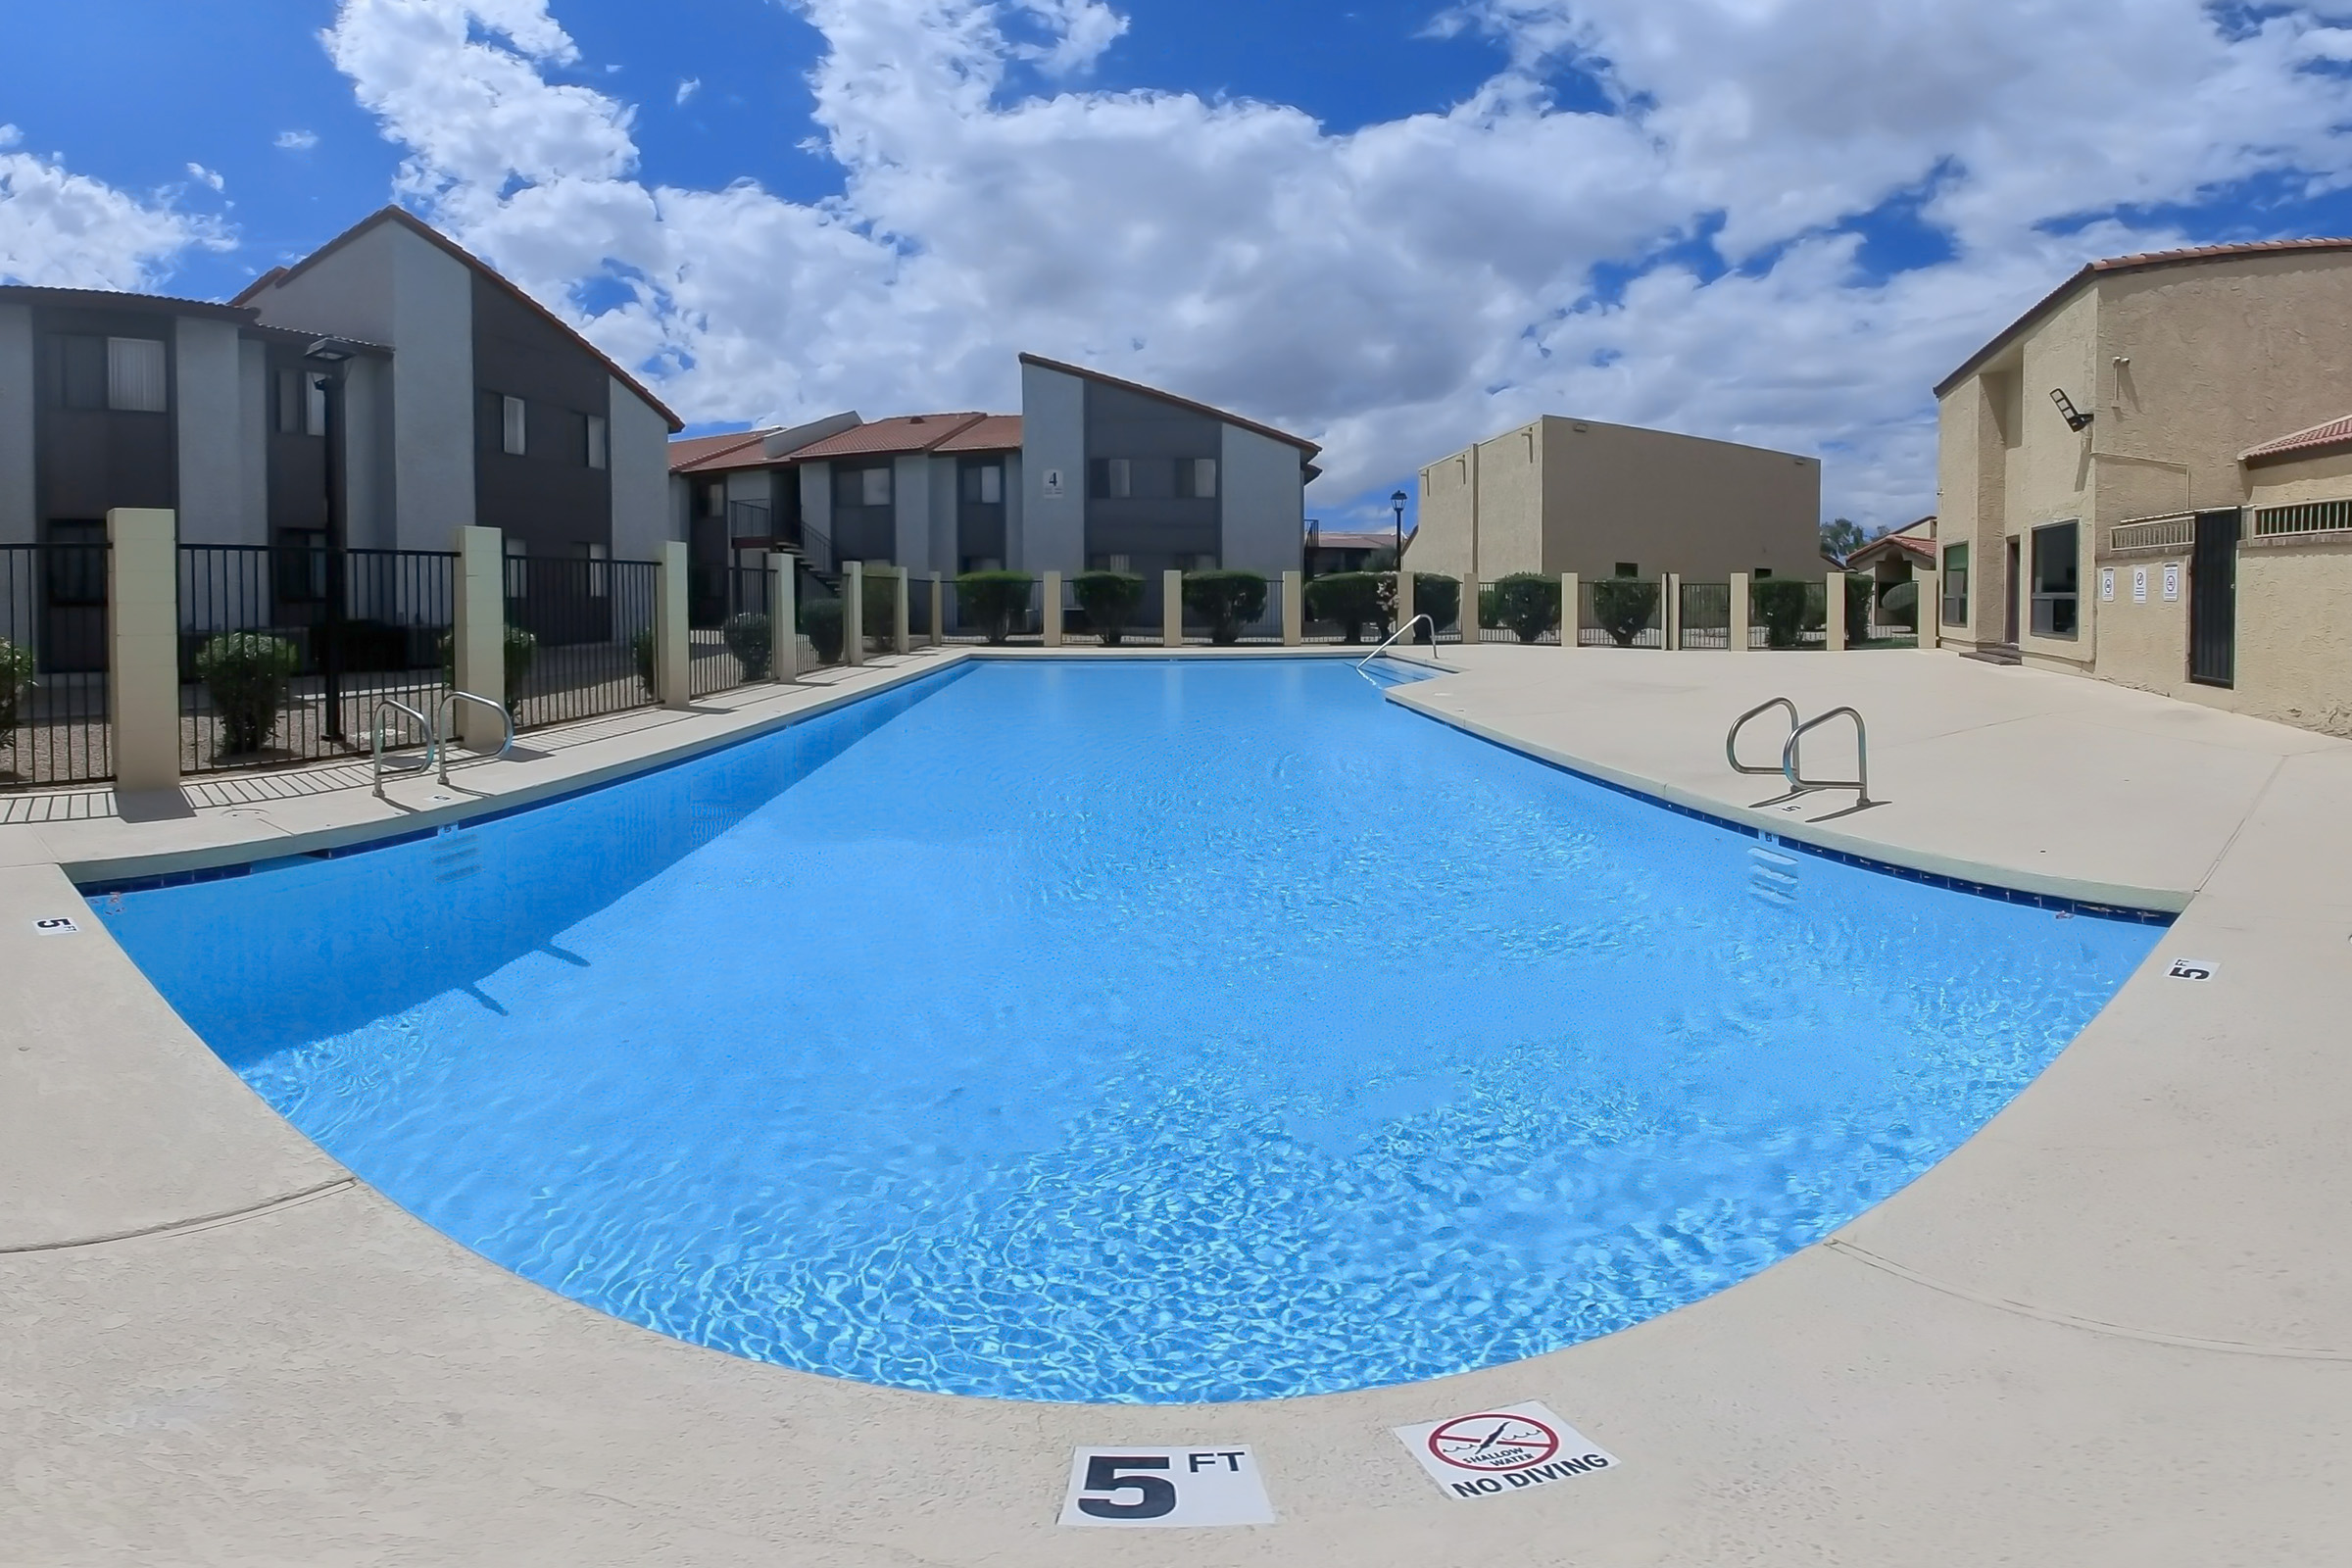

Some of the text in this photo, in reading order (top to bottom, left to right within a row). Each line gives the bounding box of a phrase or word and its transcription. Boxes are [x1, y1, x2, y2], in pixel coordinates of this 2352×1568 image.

[1049, 472, 1057, 486] 4
[37, 918, 72, 928] 5
[2169, 966, 2210, 980] 5
[1462, 1446, 1524, 1464] SHALLOW
[1492, 1452, 1536, 1467] WATER
[1450, 1453, 1609, 1497] NO DIVING
[1078, 1451, 1246, 1519] 5 FT
